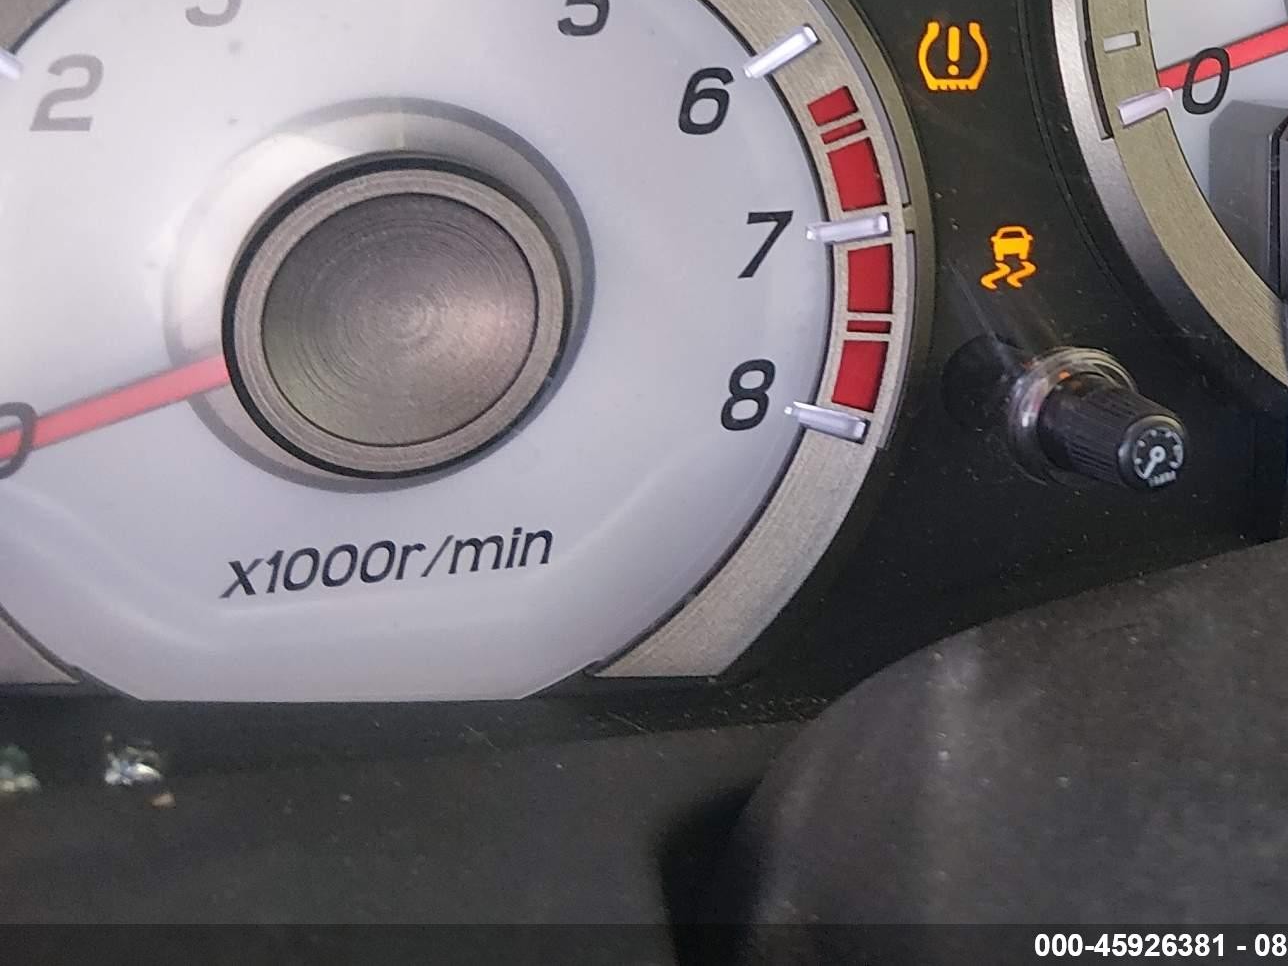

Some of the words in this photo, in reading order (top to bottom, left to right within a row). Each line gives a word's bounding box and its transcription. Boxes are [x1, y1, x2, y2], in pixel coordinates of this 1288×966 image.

[29, 55, 104, 132] 2
[677, 68, 732, 136] 6
[1182, 48, 1230, 114] 0
[737, 211, 792, 278] 7
[720, 360, 776, 432] 8
[219, 525, 554, 598] x1000r/min
